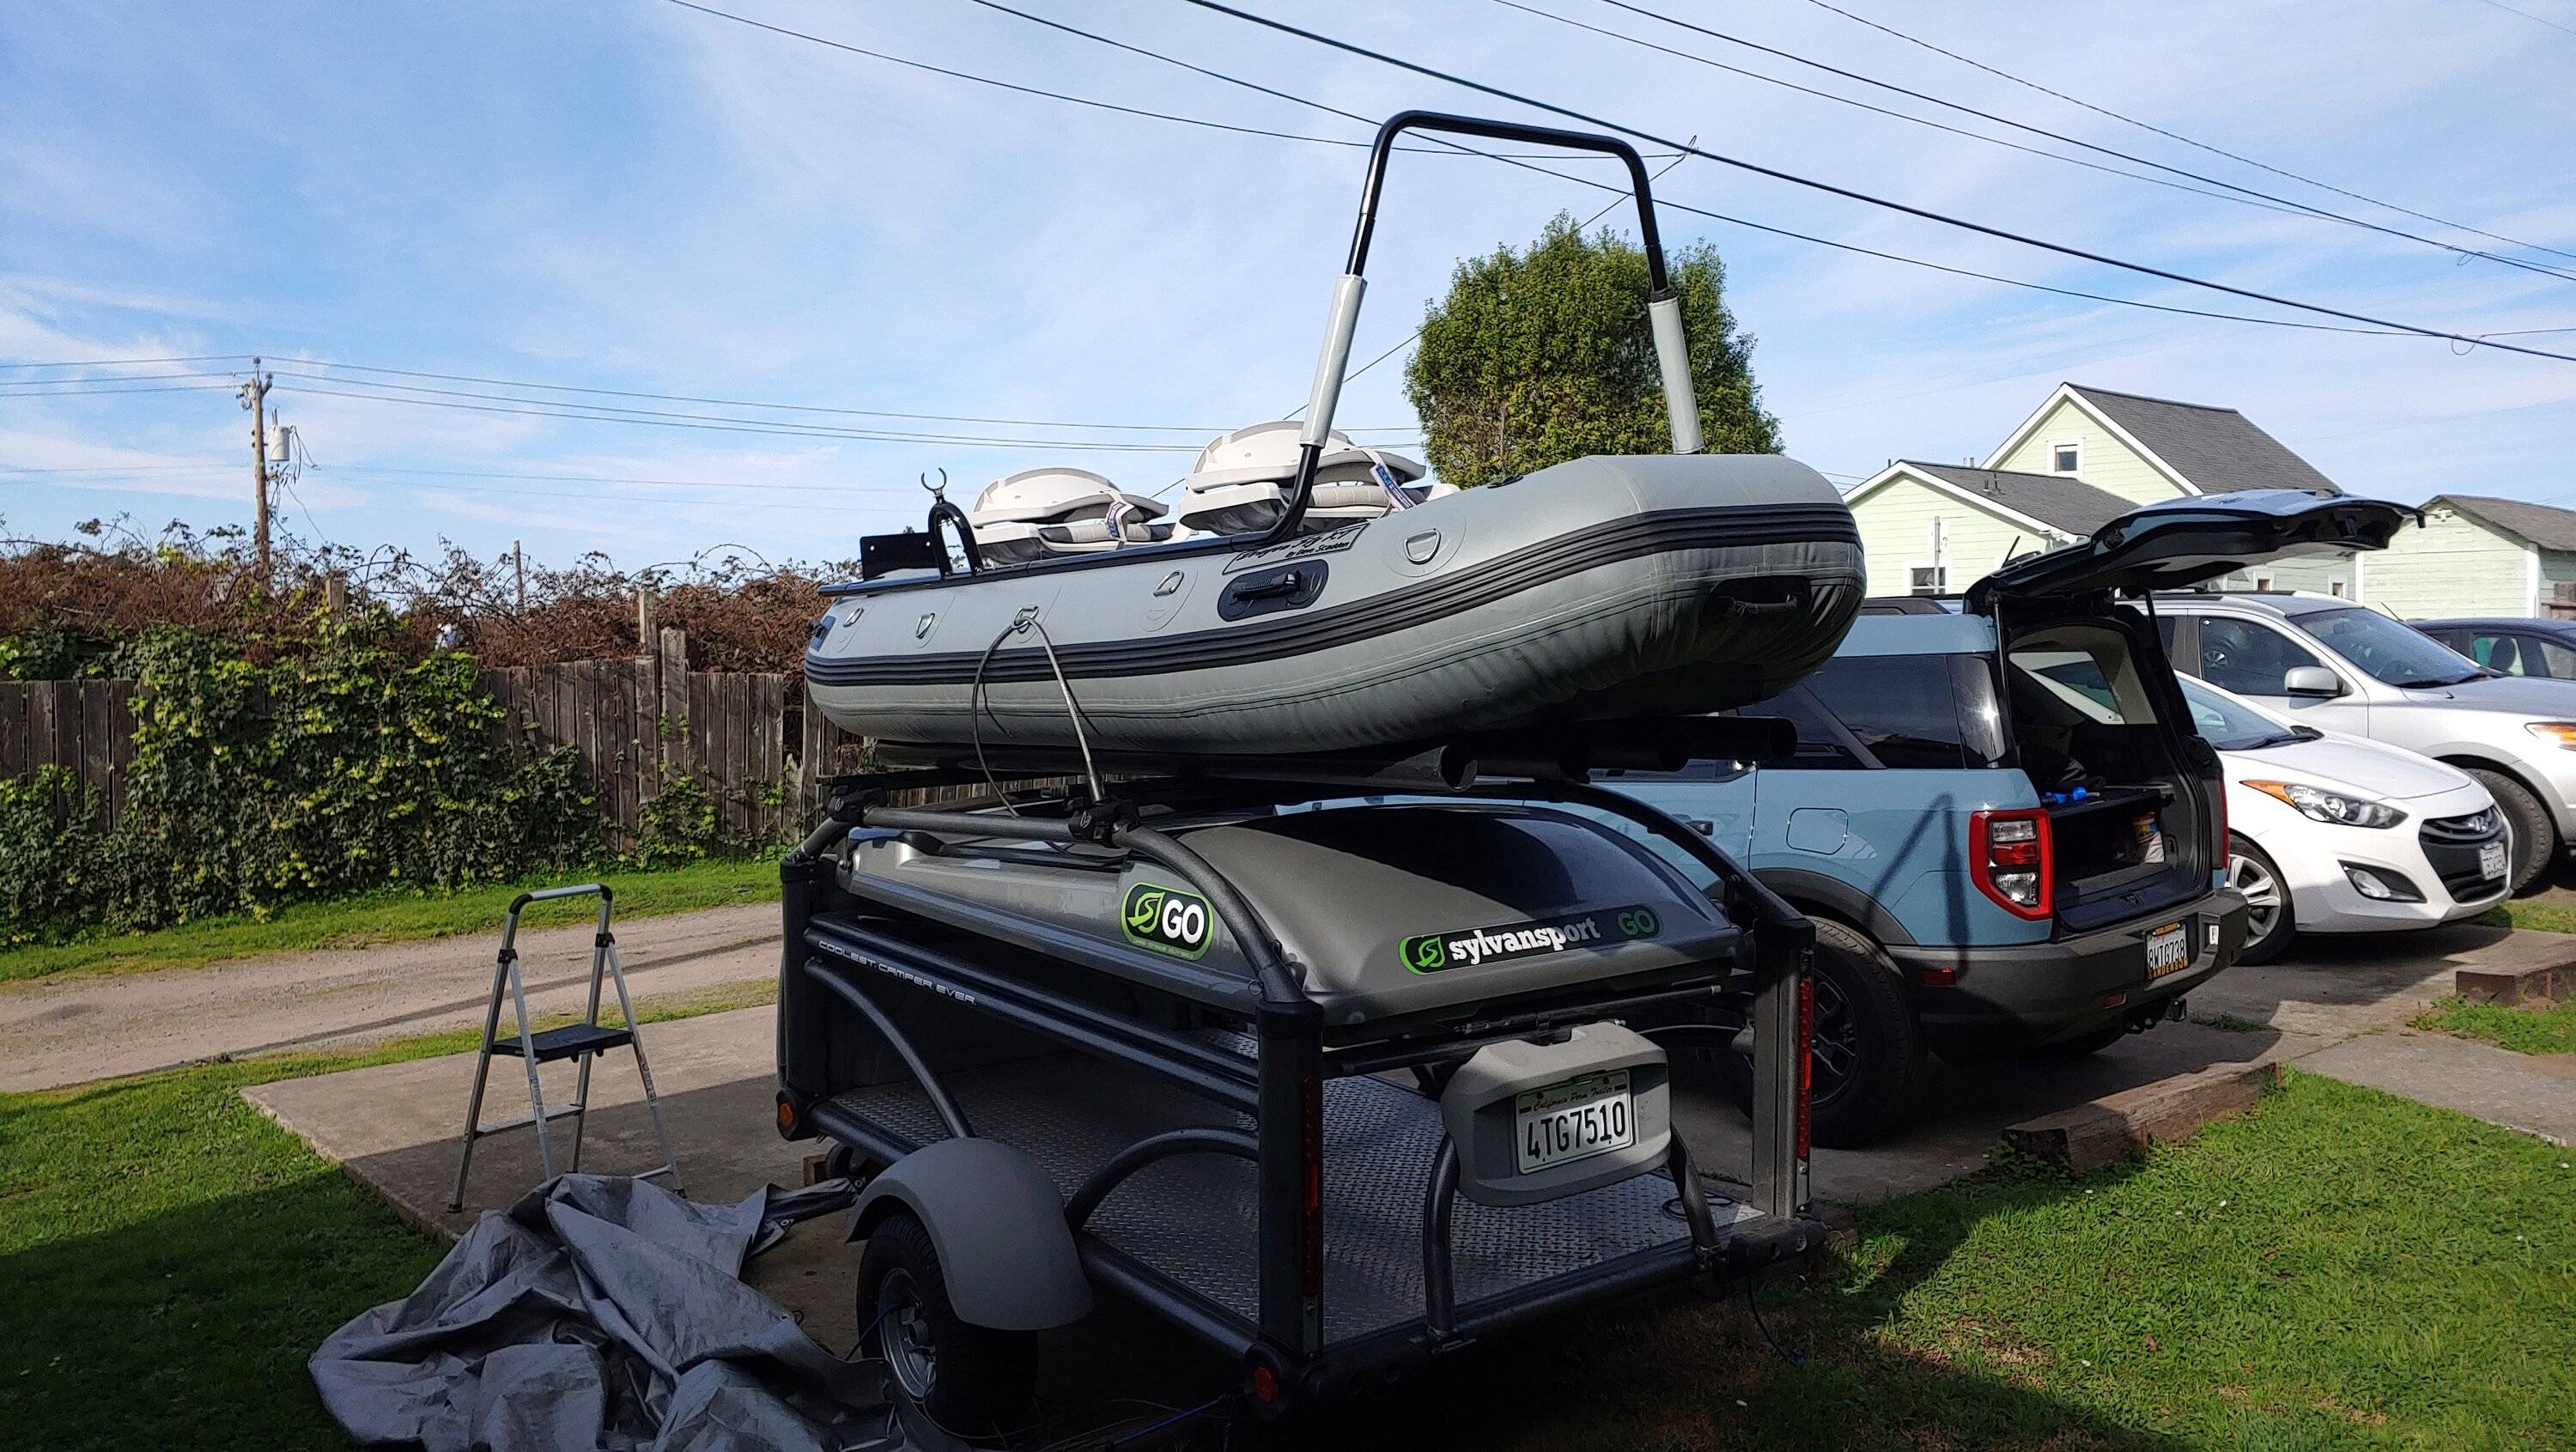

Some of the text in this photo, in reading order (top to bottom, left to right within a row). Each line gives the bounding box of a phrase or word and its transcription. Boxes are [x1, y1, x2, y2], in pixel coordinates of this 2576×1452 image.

[1162, 898, 1205, 944] GO
[1449, 909, 1656, 965] sylvansport GO
